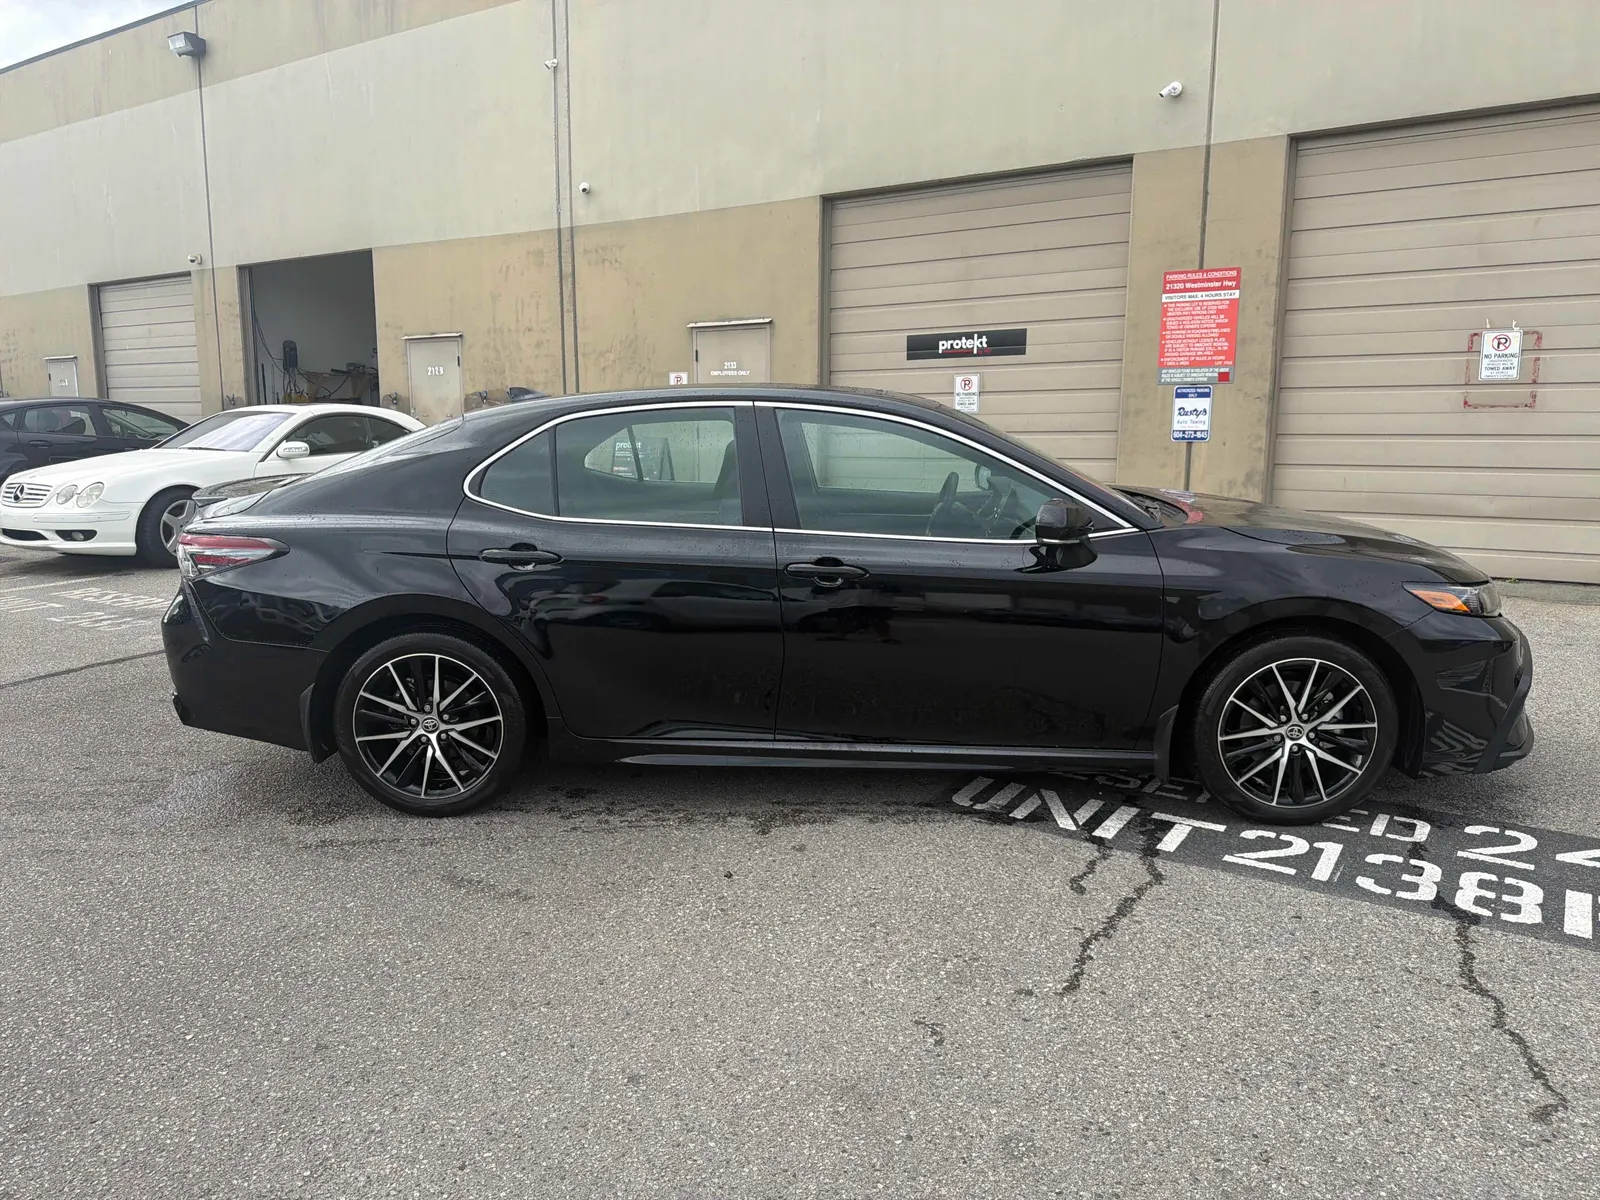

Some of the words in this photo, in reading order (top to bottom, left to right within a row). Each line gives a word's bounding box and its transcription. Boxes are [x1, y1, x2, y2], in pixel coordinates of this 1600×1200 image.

[1186, 281, 1221, 289] Westminster
[1223, 280, 1236, 288] Hwy
[939, 334, 988, 354] protekt
[952, 776, 1227, 852] UNIT
